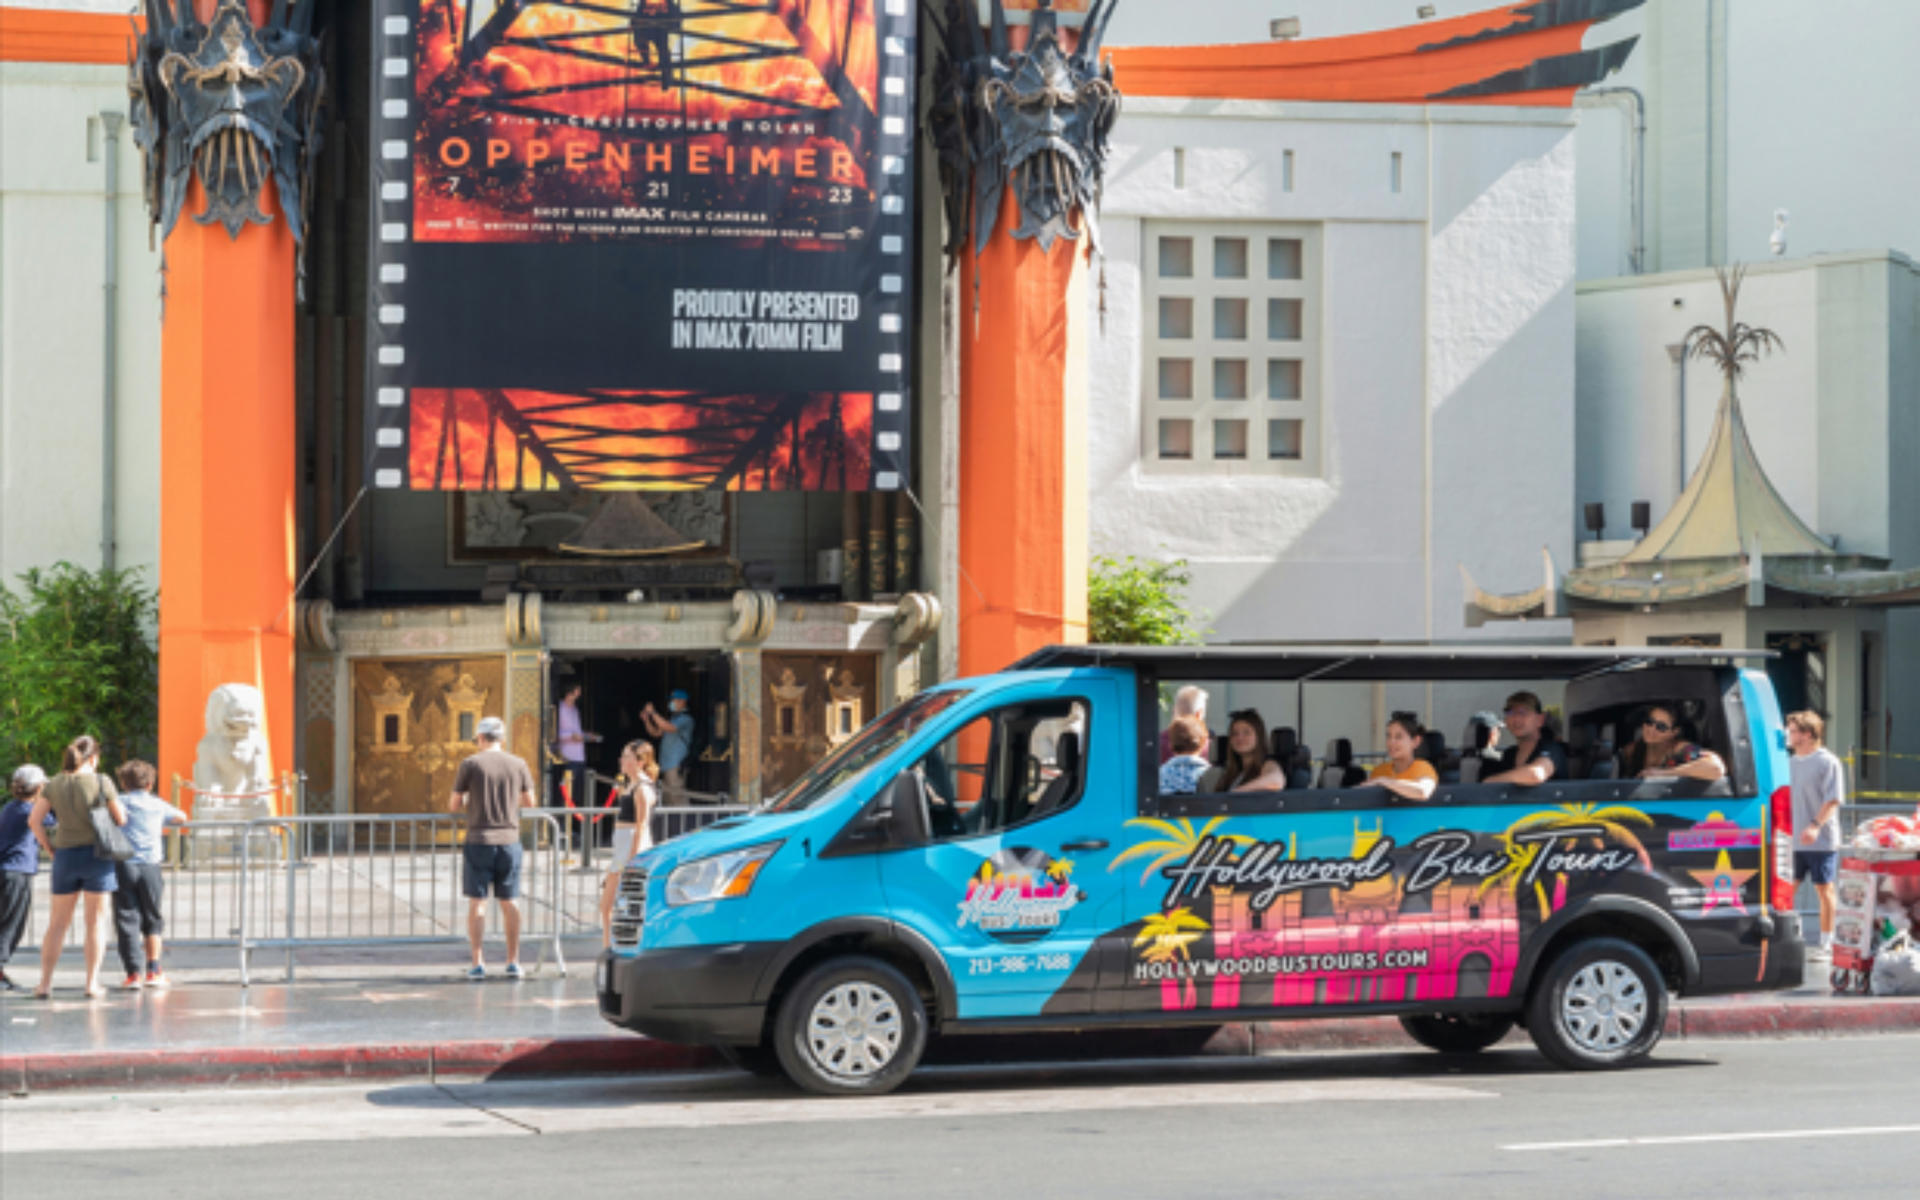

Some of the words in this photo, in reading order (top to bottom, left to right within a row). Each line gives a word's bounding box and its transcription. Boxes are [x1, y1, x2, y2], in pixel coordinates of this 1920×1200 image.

[568, 114, 729, 132] CHRISTOPHER
[742, 119, 815, 135] NOLAN
[440, 137, 853, 179] OPPENHEIMER
[447, 176, 461, 195] 7
[647, 182, 669, 199] 21
[829, 186, 852, 204] 23
[533, 206, 568, 217] SHOT
[574, 208, 607, 218] WITH
[612, 206, 666, 221] IMAX
[670, 210, 700, 221] FILM
[705, 211, 768, 222] CAMERAS
[673, 288, 755, 318] PROUDLY
[759, 291, 859, 321] PRESENTED
[672, 319, 692, 348] IN
[695, 321, 742, 349] IMAX
[745, 322, 799, 350] 70MM
[802, 323, 843, 351] FILM
[1164, 835, 1393, 909] Hollywood
[1406, 831, 1508, 892] Bus
[1514, 827, 1634, 885] Tours
[1134, 950, 1428, 980] HOLLYWOODBUSTOURS.COM
